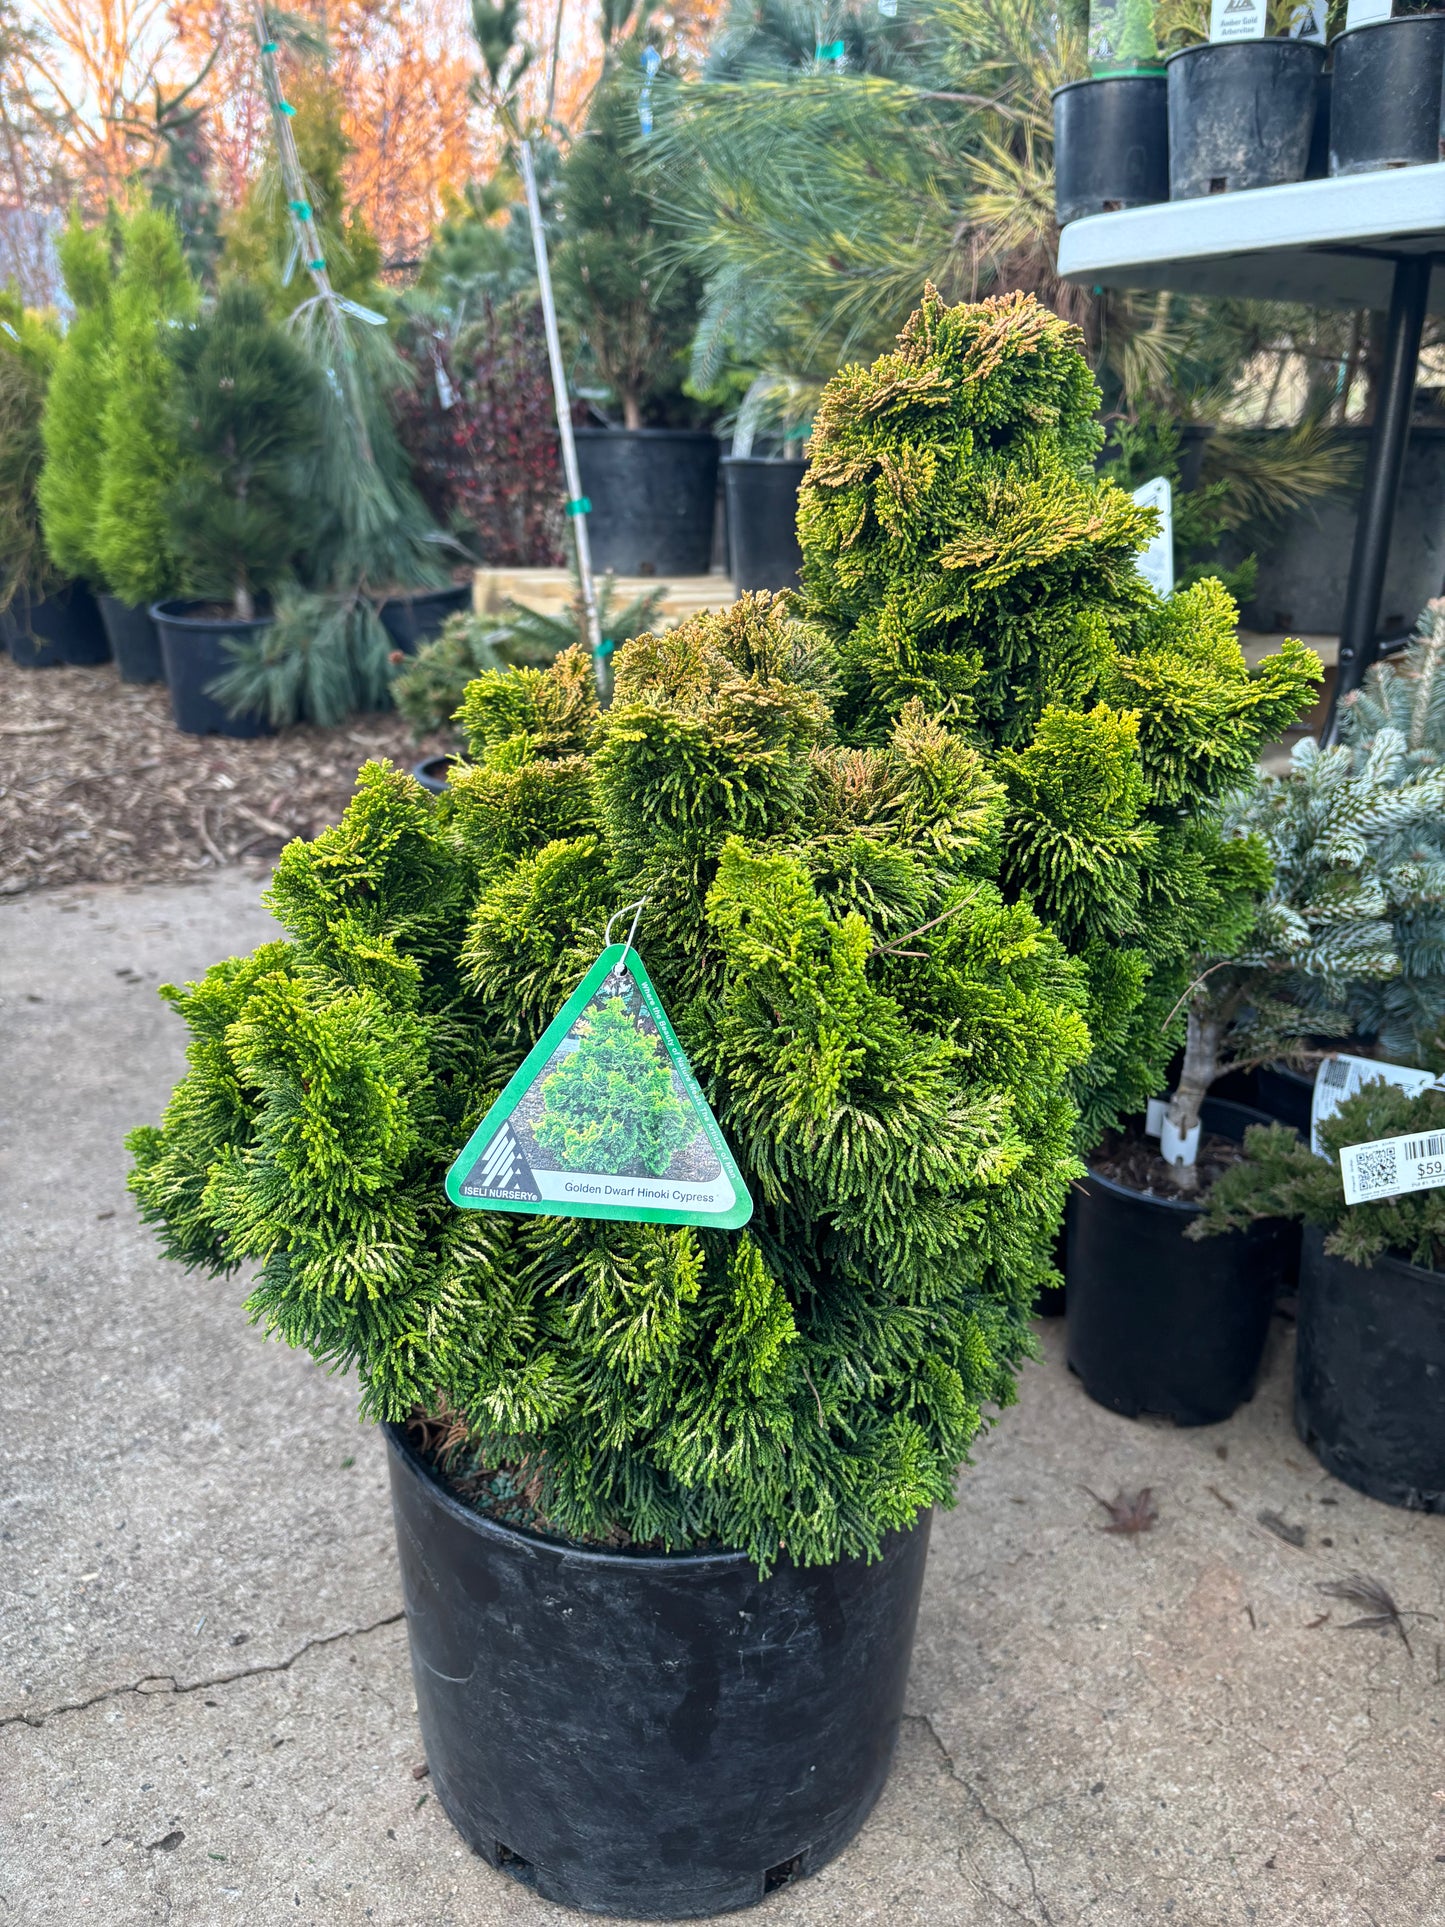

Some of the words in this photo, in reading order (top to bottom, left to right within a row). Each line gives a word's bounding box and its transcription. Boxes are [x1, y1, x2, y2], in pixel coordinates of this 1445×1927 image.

[641, 981, 656, 1006] Where
[652, 1006, 662, 1020] the
[658, 1020, 675, 1047] Beauty
[671, 1047, 680, 1056] of
[676, 1057, 691, 1082] Nature
[688, 1082, 703, 1106] Meets
[699, 1106, 710, 1122] The
[707, 1122, 723, 1151] Artistry
[720, 1152, 729, 1161] of
[464, 1186, 487, 1197] ISELI
[564, 1182, 601, 1194] Golden
[604, 1185, 635, 1197] Dwarf
[637, 1188, 670, 1199] Hinoki
[672, 1190, 715, 1203] Cypress
